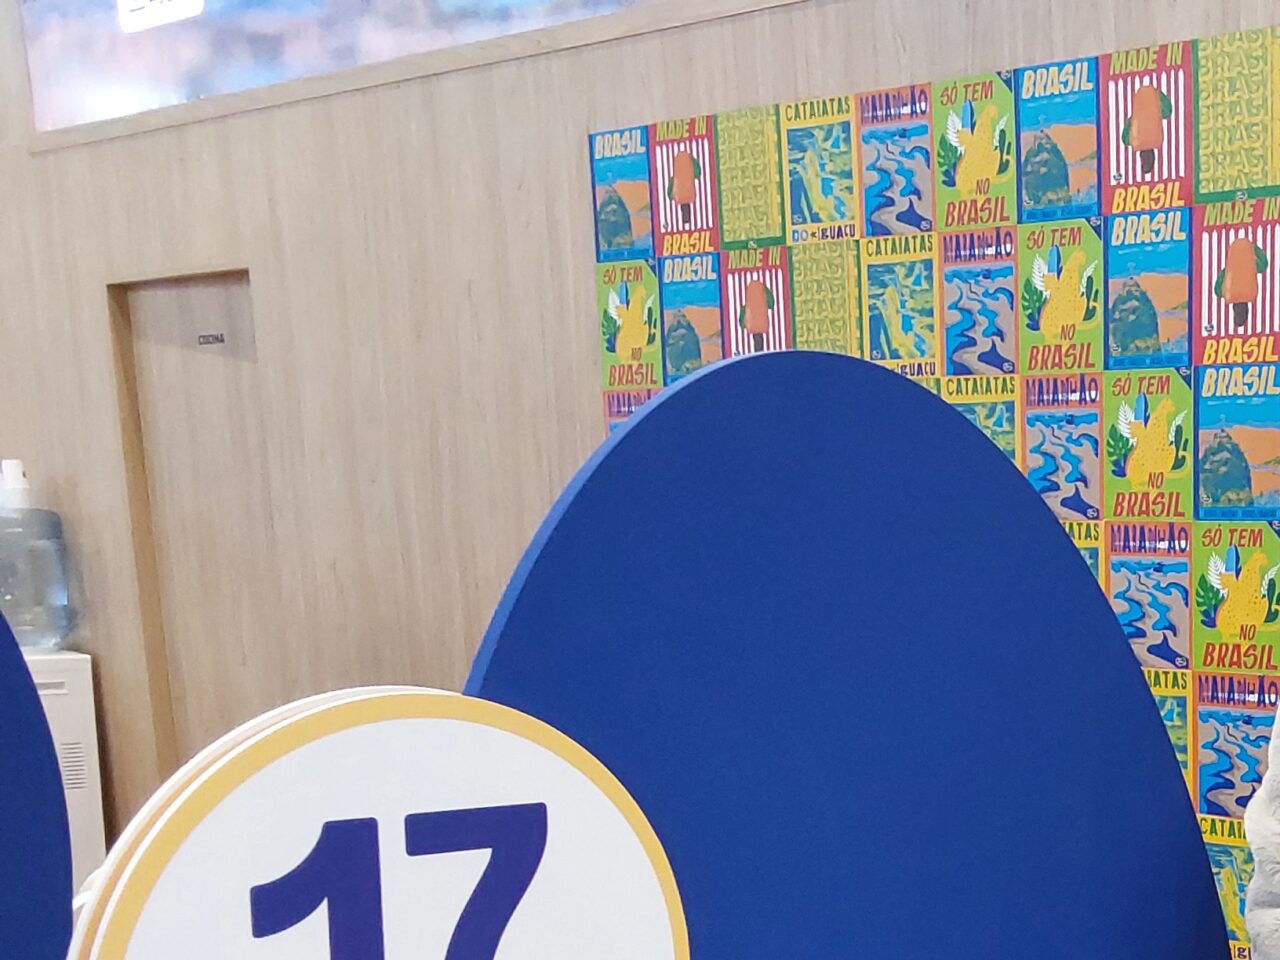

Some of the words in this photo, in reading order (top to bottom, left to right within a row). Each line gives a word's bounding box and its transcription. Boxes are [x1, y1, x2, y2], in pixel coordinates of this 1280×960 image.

[1110, 45, 1158, 75] MADE
[1166, 42, 1184, 66] IN
[941, 81, 958, 106] SÓ
[963, 80, 993, 102] TEM
[1022, 61, 1093, 99] BRASIL
[656, 118, 691, 141] MADE
[694, 115, 706, 136] IN
[595, 129, 646, 160] BRASIL
[976, 178, 990, 196] NO
[1112, 182, 1184, 214] BRASIL
[945, 196, 1010, 227] BRASIL
[1203, 200, 1256, 227] MADE
[1262, 197, 1280, 222] IN
[791, 229, 808, 242] DO
[1027, 225, 1044, 249] SÓ
[1051, 227, 1081, 247] TEM
[1111, 211, 1186, 246] BRASIL
[663, 230, 714, 256] BRASIL
[663, 255, 717, 283] BRASIL
[728, 248, 763, 269] MADE
[769, 246, 781, 266] IN
[603, 265, 616, 285] SÓ
[620, 266, 643, 283] TEM
[1060, 324, 1076, 341] NO
[631, 347, 642, 360] NO
[1028, 343, 1095, 371] BRASIL
[1203, 336, 1279, 364] BRASIL
[608, 363, 657, 386] BRASIL
[1112, 374, 1131, 397] SÓ
[1138, 375, 1171, 396] TEM
[1202, 365, 1280, 398] BRASIL
[1147, 472, 1164, 489] NO
[1113, 491, 1185, 518] BRASIL
[1202, 524, 1221, 547] SÓ
[1228, 528, 1263, 547] TEM
[1239, 624, 1256, 641] NO
[1202, 642, 1278, 671] BRASIL
